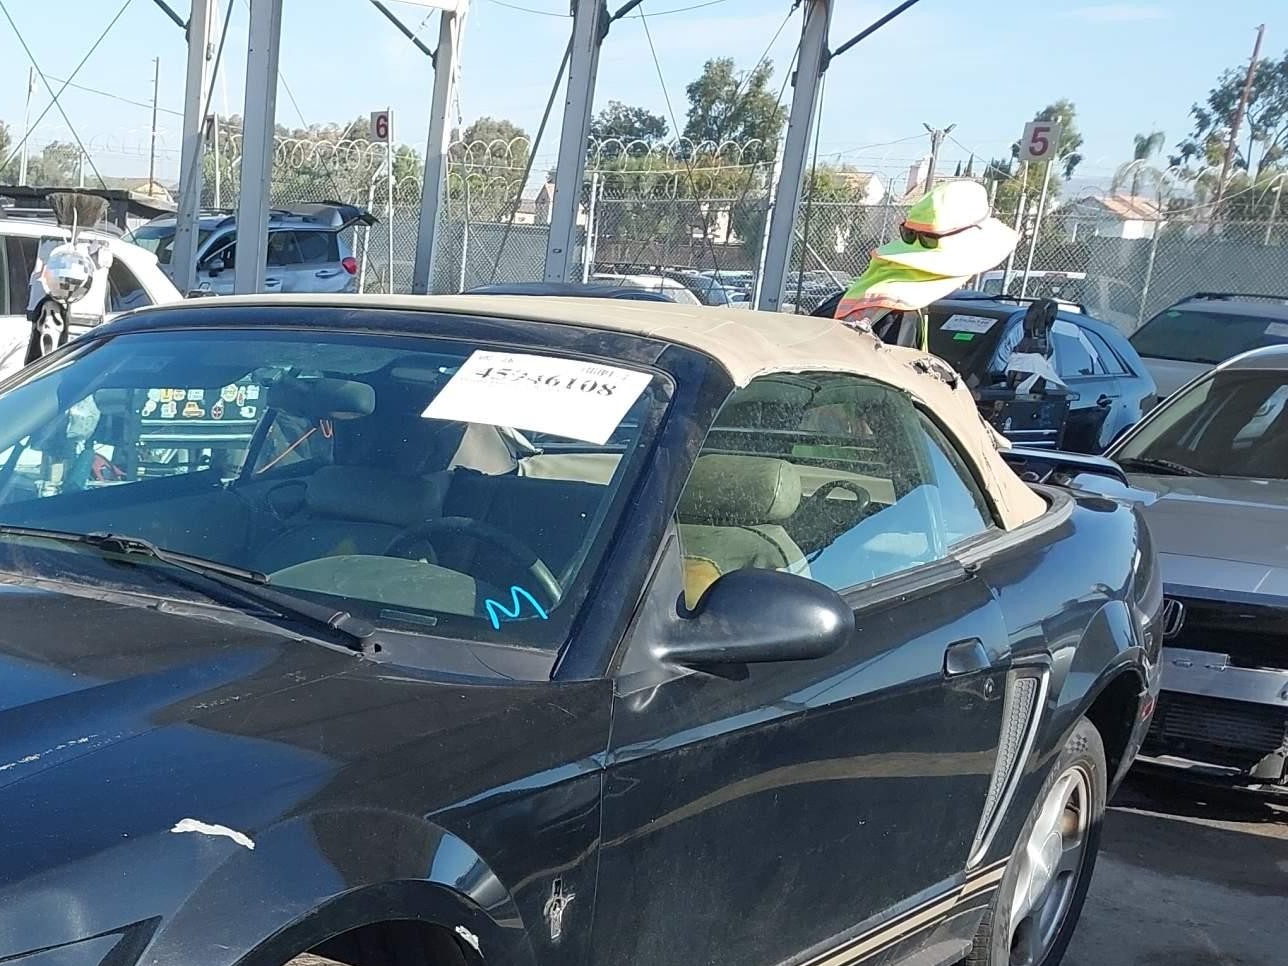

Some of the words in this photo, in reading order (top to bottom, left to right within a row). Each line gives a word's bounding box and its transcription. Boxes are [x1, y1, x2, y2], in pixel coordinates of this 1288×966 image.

[376, 114, 388, 139] 6
[1028, 126, 1051, 157] 5
[485, 586, 548, 629] M
